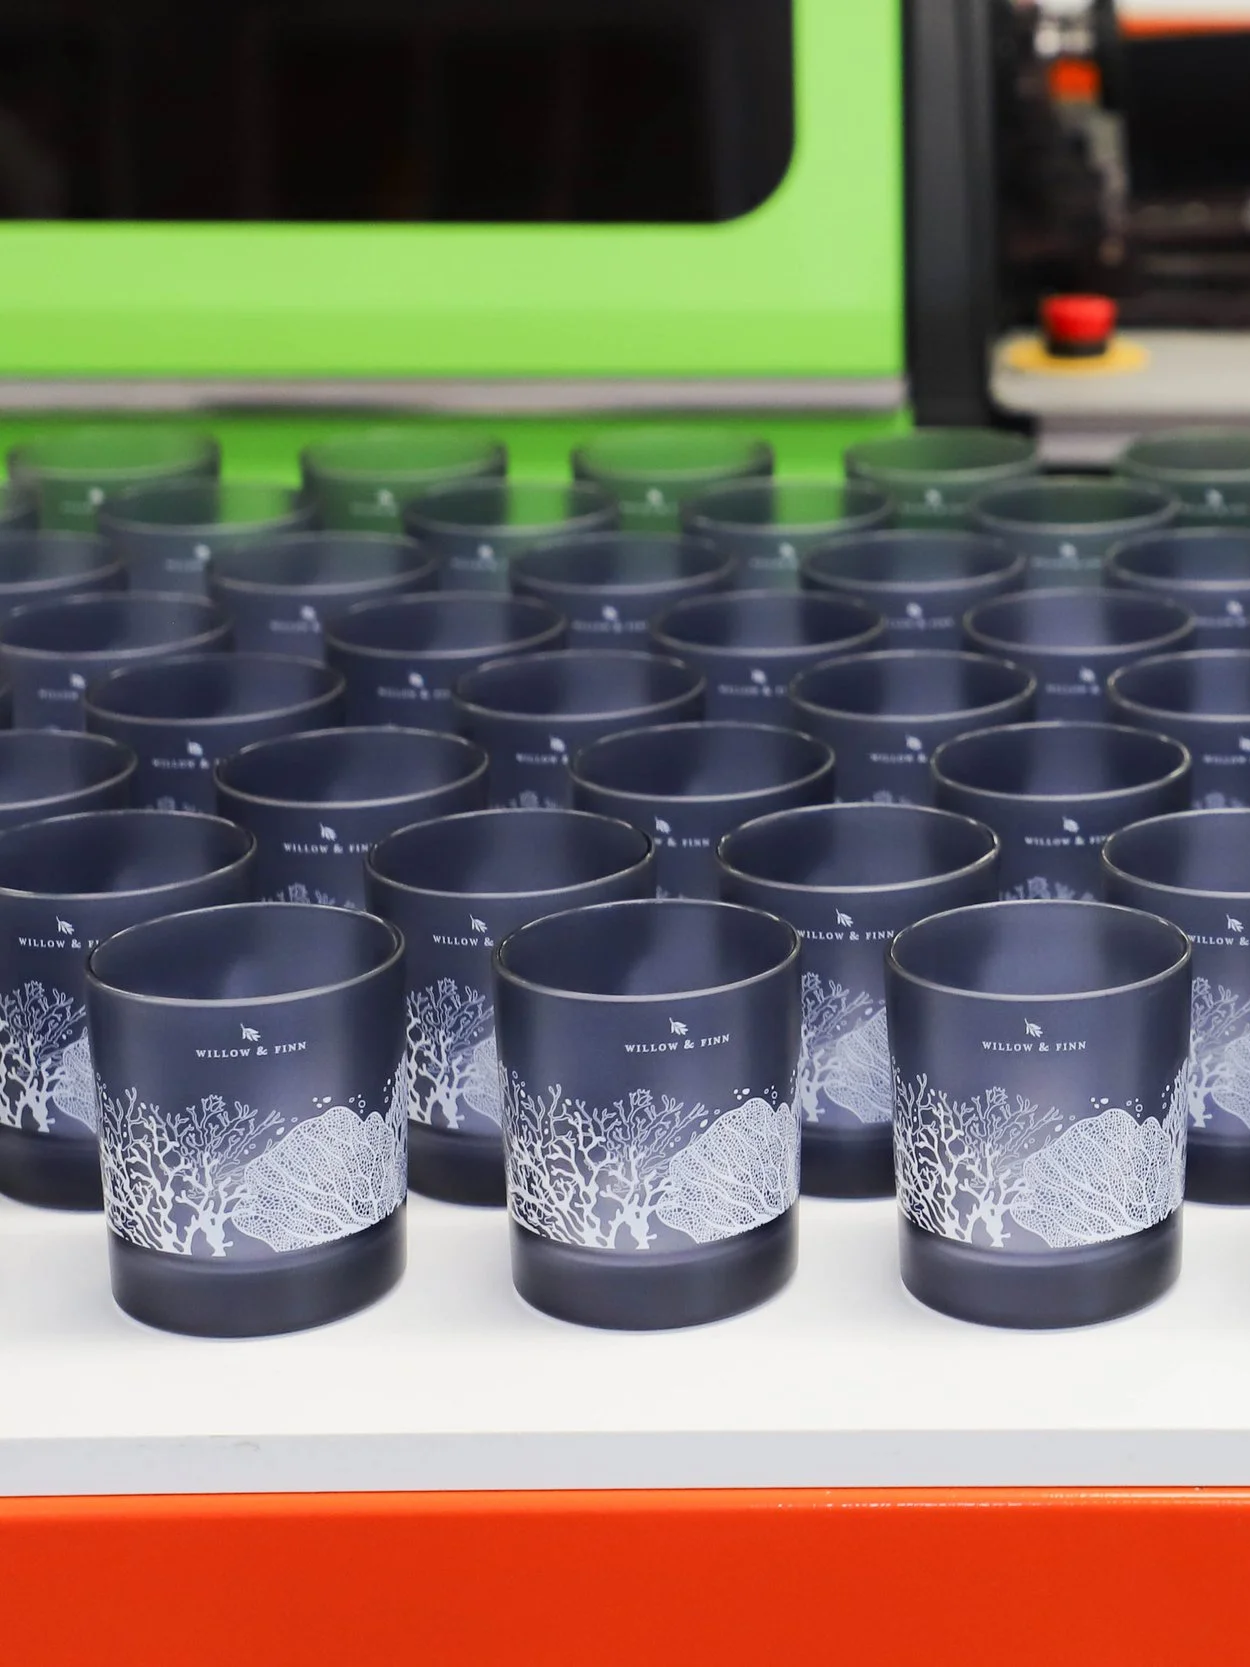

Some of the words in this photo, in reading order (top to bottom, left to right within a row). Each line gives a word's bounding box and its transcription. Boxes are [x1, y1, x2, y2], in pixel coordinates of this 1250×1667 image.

[667, 838, 677, 847] &
[682, 838, 710, 848] FINN
[1025, 836, 1070, 847] WILLOW
[1075, 836, 1085, 846] &
[283, 842, 328, 854] WILLOW
[333, 844, 343, 854] &
[349, 843, 374, 853] FIN
[432, 934, 479, 947] WILLOW
[483, 937, 493, 947] &
[796, 930, 845, 941] WILLOW
[849, 930, 860, 941] &
[865, 930, 894, 941] FINN
[1187, 934, 1234, 946] WILLOW
[1239, 936, 1249, 946] &
[18, 937, 65, 949] WILLOW
[71, 938, 82, 949] &
[624, 1042, 679, 1053] WILLOW
[683, 1039, 694, 1050] &
[700, 1034, 730, 1047] FINN
[982, 1041, 1033, 1052] WILLOW
[1038, 1041, 1049, 1052] &
[1056, 1041, 1087, 1052] FINN
[196, 1047, 250, 1059] WILLOW
[256, 1045, 268, 1056] &
[274, 1041, 307, 1054] FINN
